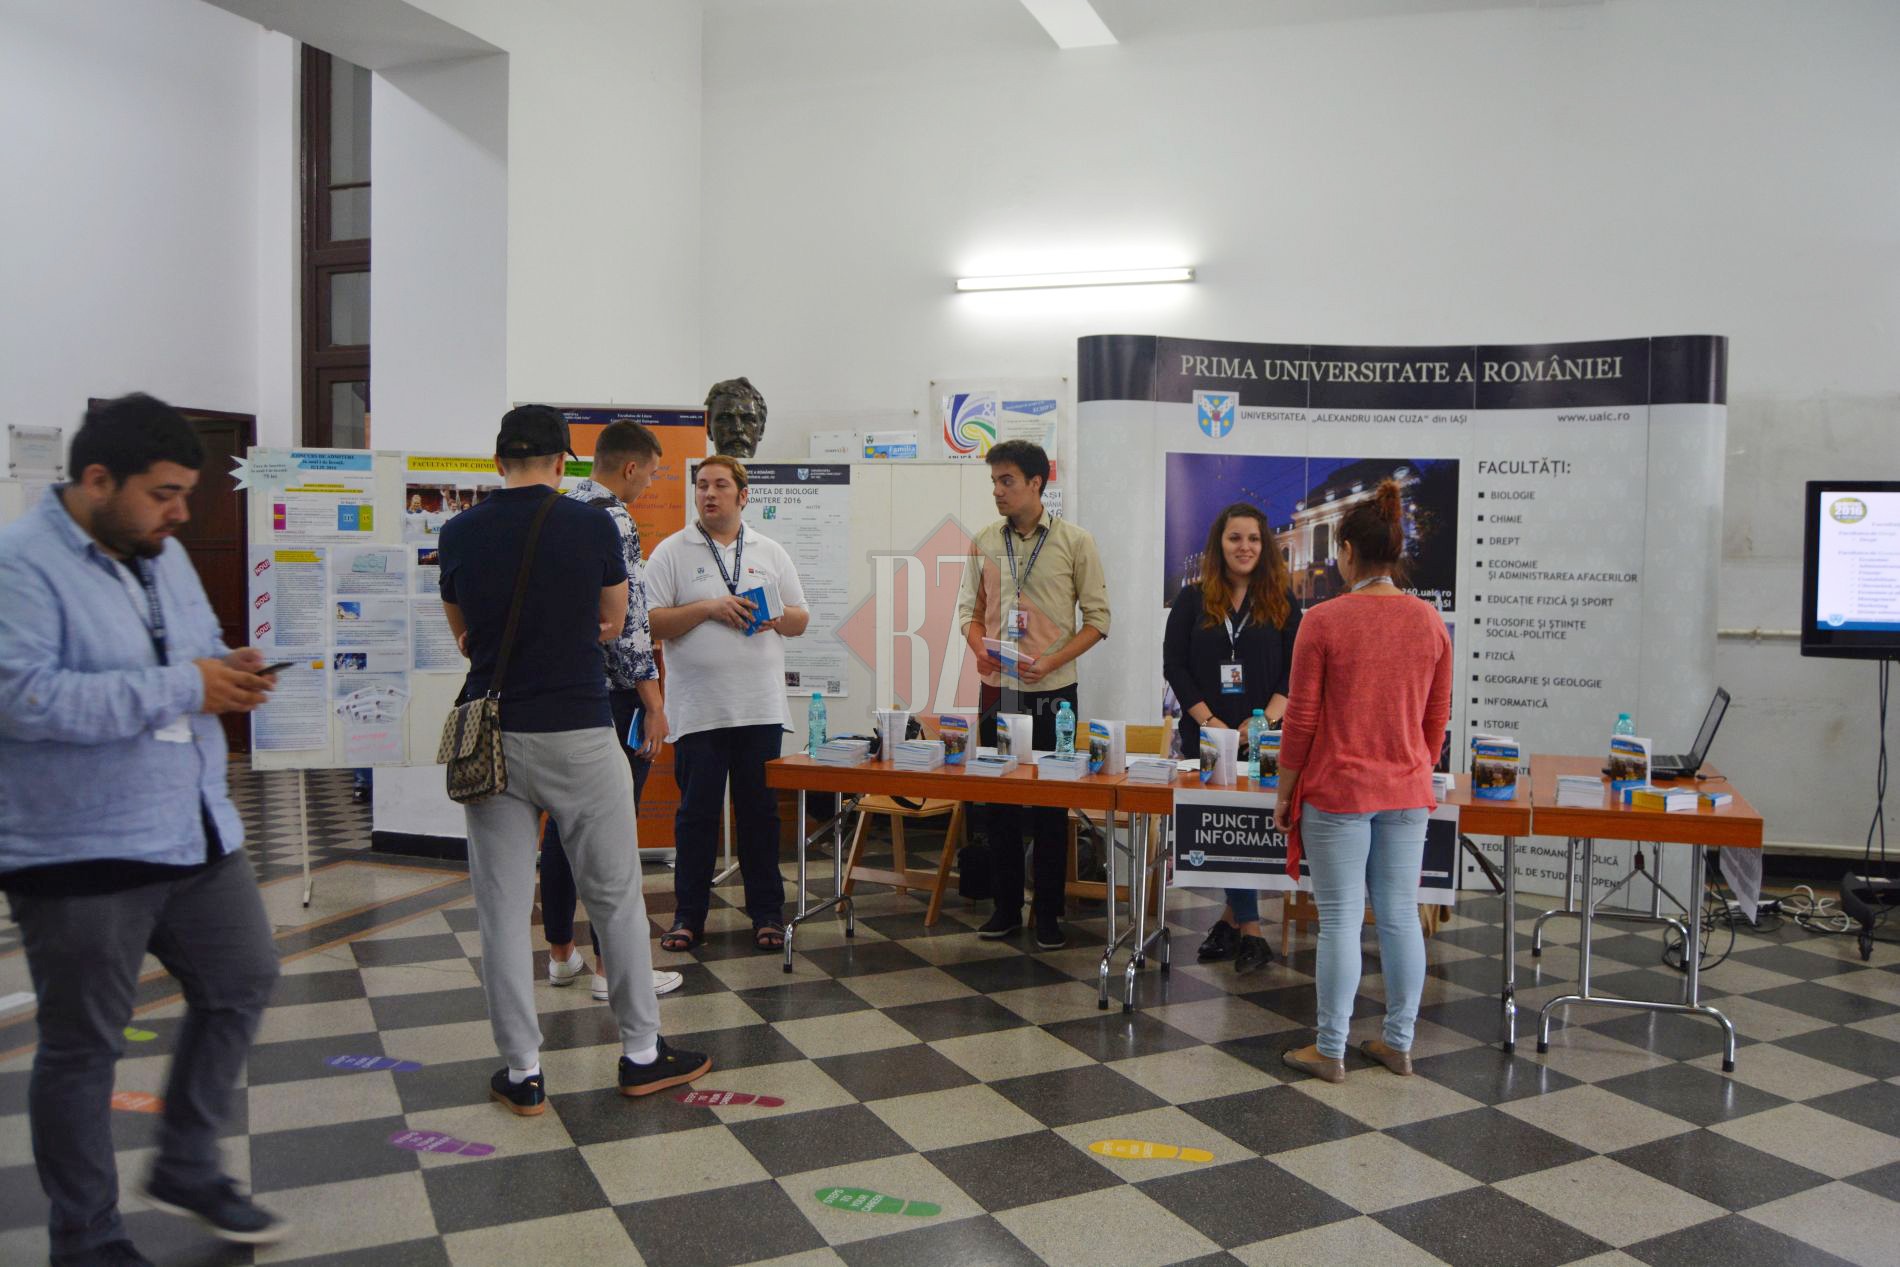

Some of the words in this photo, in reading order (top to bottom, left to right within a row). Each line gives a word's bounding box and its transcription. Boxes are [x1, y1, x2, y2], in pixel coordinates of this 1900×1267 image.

[1180, 354, 1258, 380] PRIMA
[1264, 359, 1450, 383] UNIVERSITATE
[1455, 361, 1474, 382] A
[1482, 355, 1623, 383] ROMÂNIEI
[1241, 410, 1306, 422] UNIVERSITATEA
[1373, 414, 1396, 424] IOAN
[1432, 414, 1447, 424] din
[1557, 412, 1630, 422] www.uaic.ro
[1478, 456, 1571, 478] FACULTĂȚI:
[1490, 491, 1536, 500] BIOLOGIE
[1490, 515, 1523, 523] CHIMIE
[1489, 537, 1520, 545] DREPT
[255, 560, 271, 576] NOU!
[1488, 560, 1538, 568] ECONOMIE
[1498, 572, 1575, 581] ADMINISTRAREA
[1576, 572, 1638, 583] AFACERILOR
[255, 592, 271, 608] NOU!
[1536, 595, 1567, 606] FIZICĂ
[1582, 598, 1614, 607] SPORT
[1486, 618, 1534, 627] FILOSOFIE
[255, 622, 271, 639] NOU!
[1486, 630, 1567, 639] SOCIAL-POLITICE
[1485, 651, 1515, 661] FIZICĂ
[1485, 675, 1538, 685] GEOGRAFIE
[1553, 678, 1602, 688] GEOLOGIE
[1484, 698, 1549, 708] INFORMATICĂ
[1484, 720, 1520, 730] ISTORIE
[1202, 813, 1260, 830] PUNCT
[1526, 868, 1537, 877] DE
[1574, 874, 1622, 890] EUOPENE
